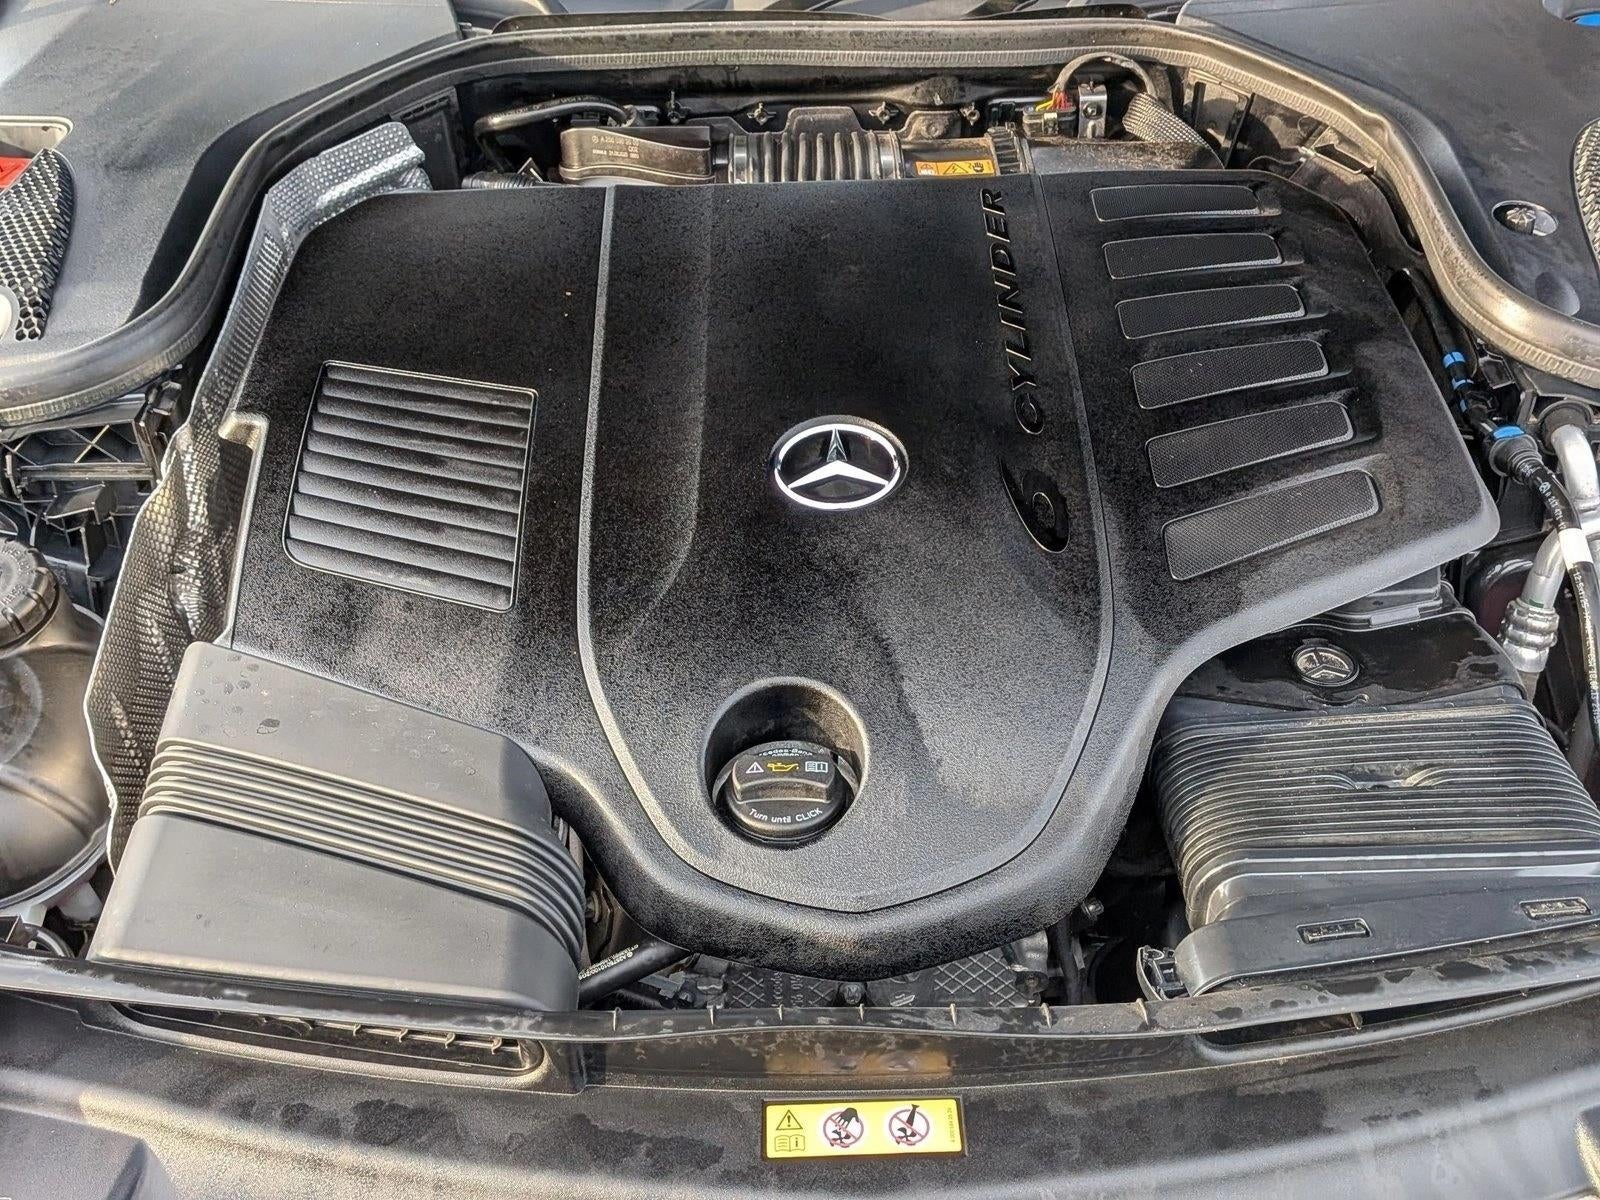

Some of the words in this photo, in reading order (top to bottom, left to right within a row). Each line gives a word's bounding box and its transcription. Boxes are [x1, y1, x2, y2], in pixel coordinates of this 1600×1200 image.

[979, 187, 1046, 436] CYLINDER
[998, 455, 1070, 554] 6
[749, 808, 768, 821] Turn
[771, 815, 792, 824] until
[795, 807, 823, 822] CLICK
